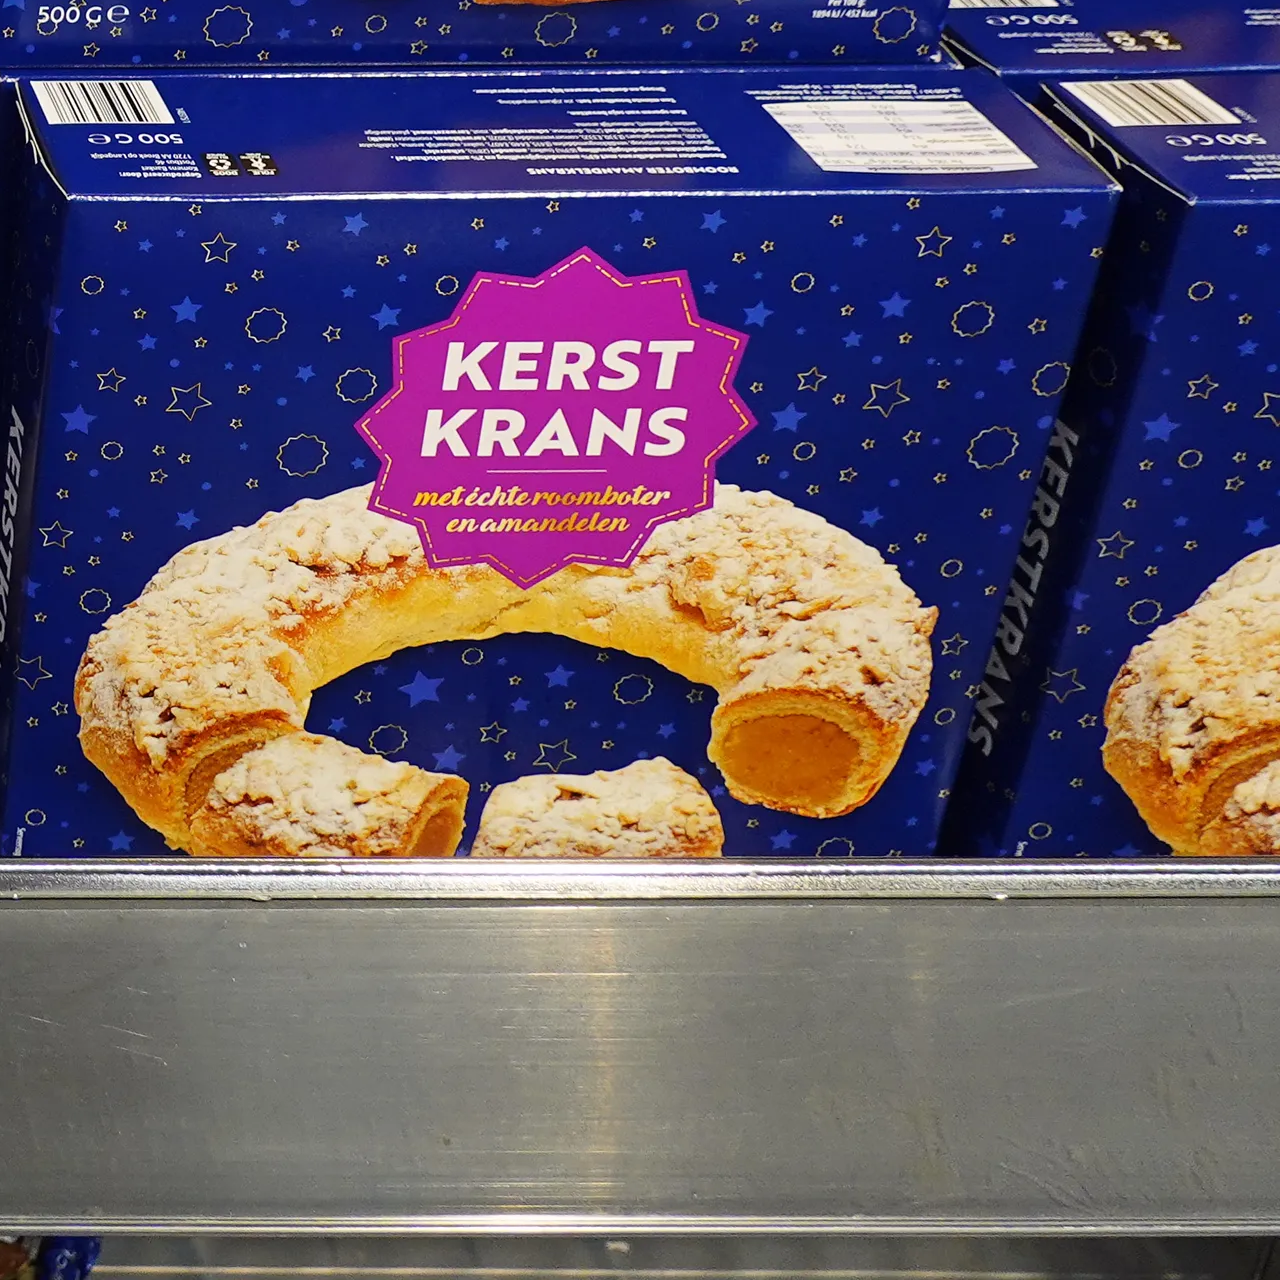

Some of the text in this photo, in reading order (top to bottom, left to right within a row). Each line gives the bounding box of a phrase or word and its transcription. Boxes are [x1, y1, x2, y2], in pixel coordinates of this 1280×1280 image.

[38, 6, 80, 23] 500
[86, 6, 102, 23] G
[114, 133, 133, 144] G
[137, 133, 184, 144] 500
[143, 171, 202, 179] Geproduceerd
[526, 166, 739, 175] ROOMBOTER AMANDELKRANS
[442, 340, 695, 391] KERST
[420, 407, 688, 457] KRANS
[413, 485, 464, 506] met
[531, 485, 671, 506] roomboter
[446, 512, 630, 533] en amandelen
[967, 417, 1081, 756] KERSTKRANS
